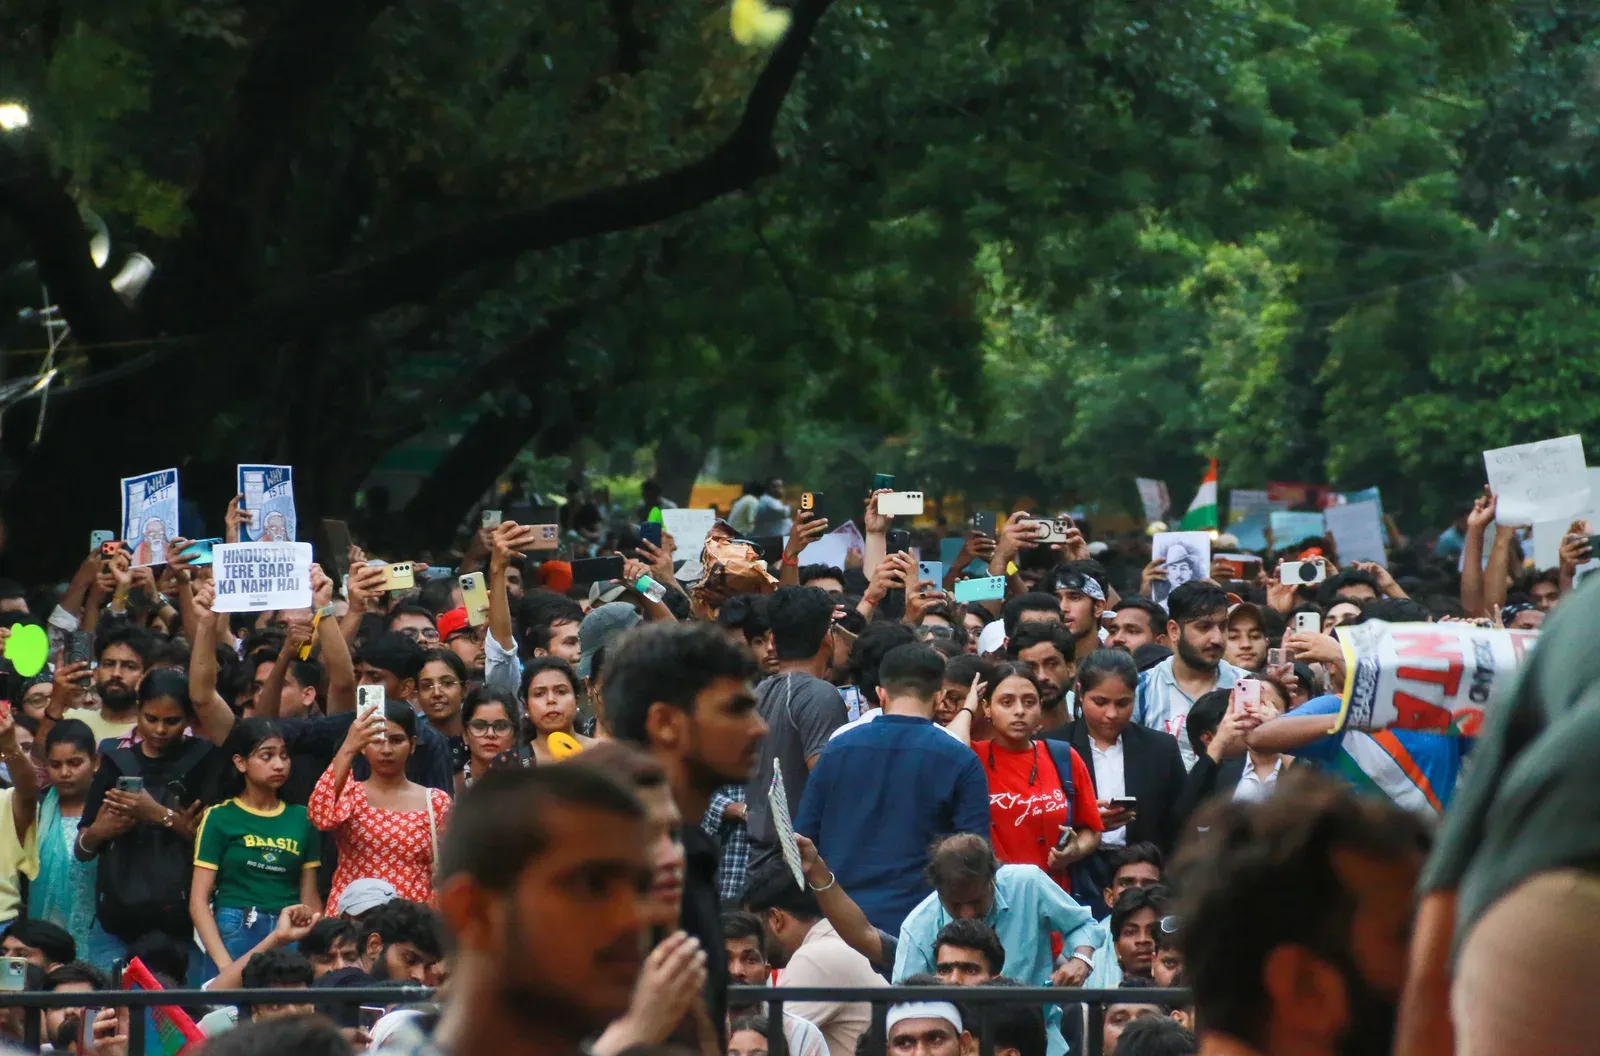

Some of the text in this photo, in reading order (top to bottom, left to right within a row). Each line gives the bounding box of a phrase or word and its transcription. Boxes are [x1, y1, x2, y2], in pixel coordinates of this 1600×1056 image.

[148, 471, 168, 493] WHY
[265, 468, 283, 487] WHY
[149, 485, 172, 505] IS IT
[269, 482, 287, 498] IS IT
[223, 548, 296, 564] HINDUSTAN
[224, 563, 294, 579] TERE BAAP
[218, 578, 300, 594] KA NAHI HAI
[243, 834, 300, 856] BRASIL
